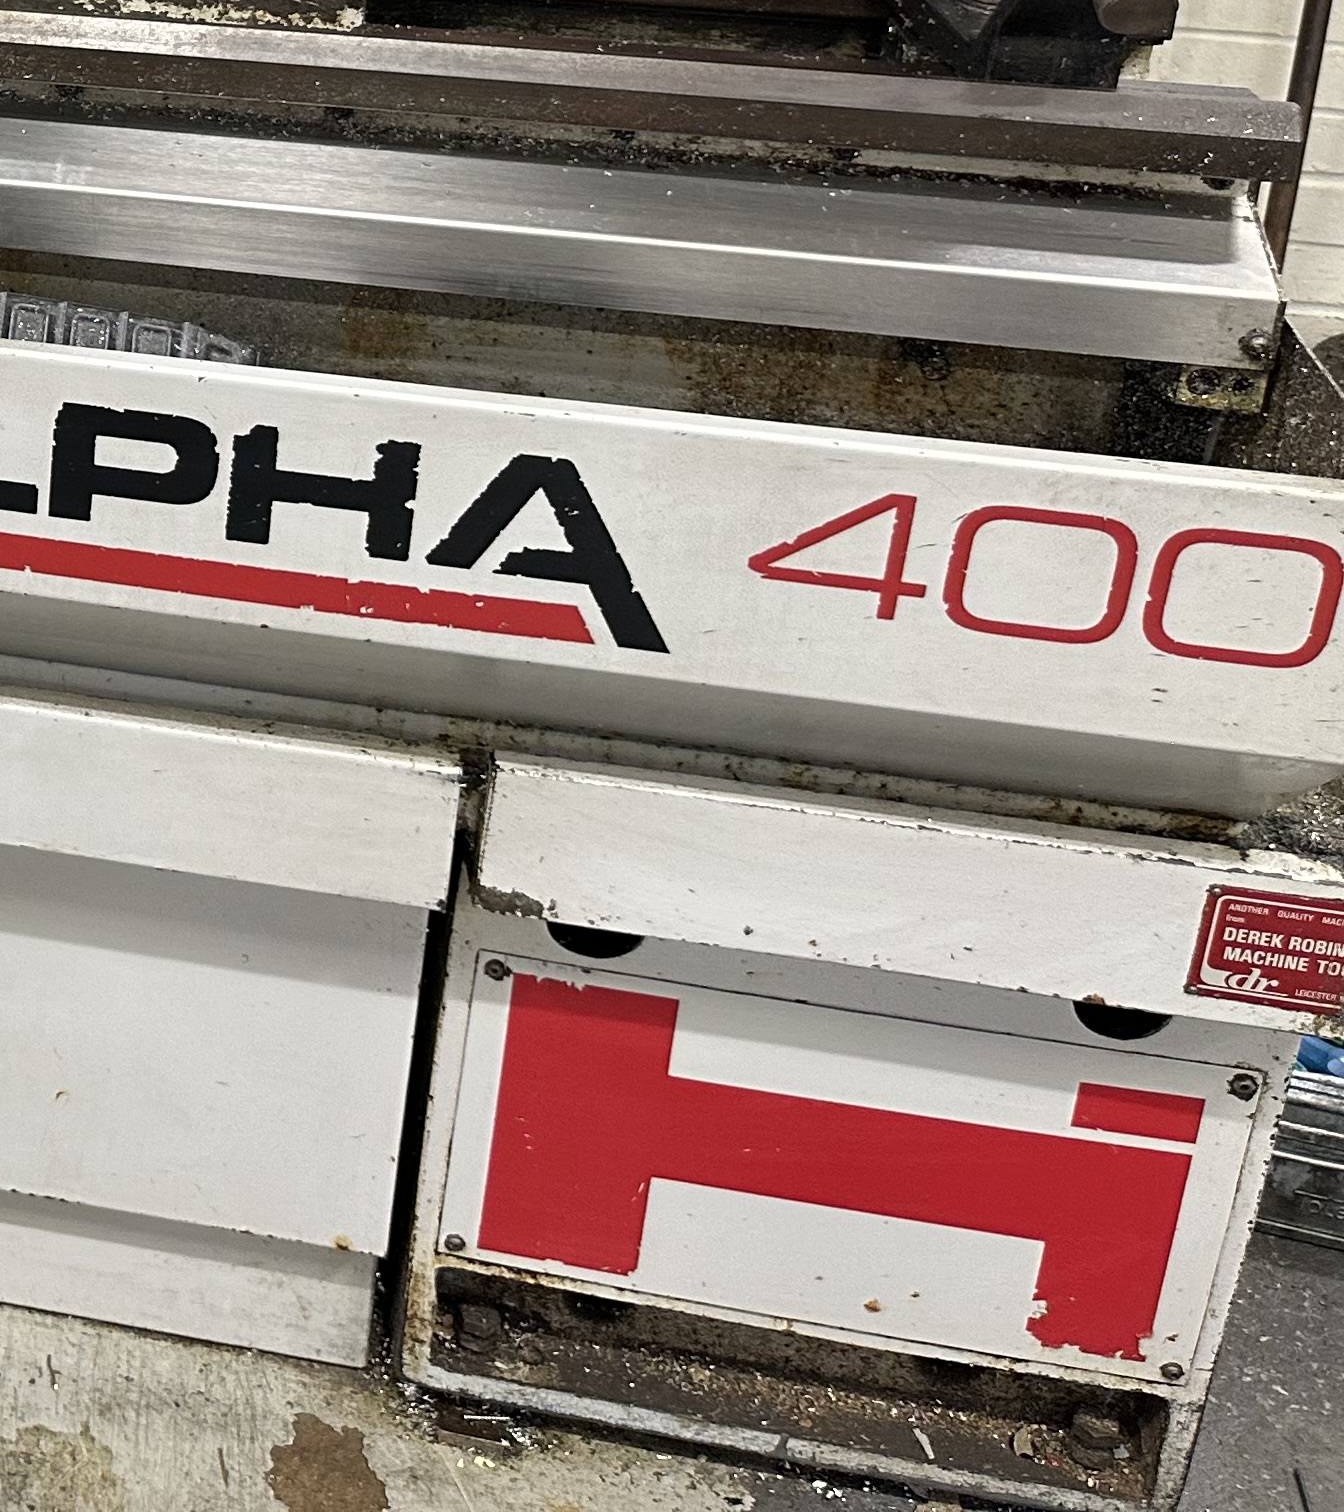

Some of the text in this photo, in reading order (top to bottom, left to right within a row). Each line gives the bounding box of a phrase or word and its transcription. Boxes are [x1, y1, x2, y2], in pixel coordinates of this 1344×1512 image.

[747, 493, 1344, 669] 400
[1225, 914, 1245, 923] from
[1228, 903, 1269, 915] ANOTHER
[1277, 910, 1314, 922] QUALITY
[1223, 927, 1284, 949] DEREK
[1223, 946, 1344, 976] MACHINE TO
[1295, 989, 1336, 1001] LEICESTER
